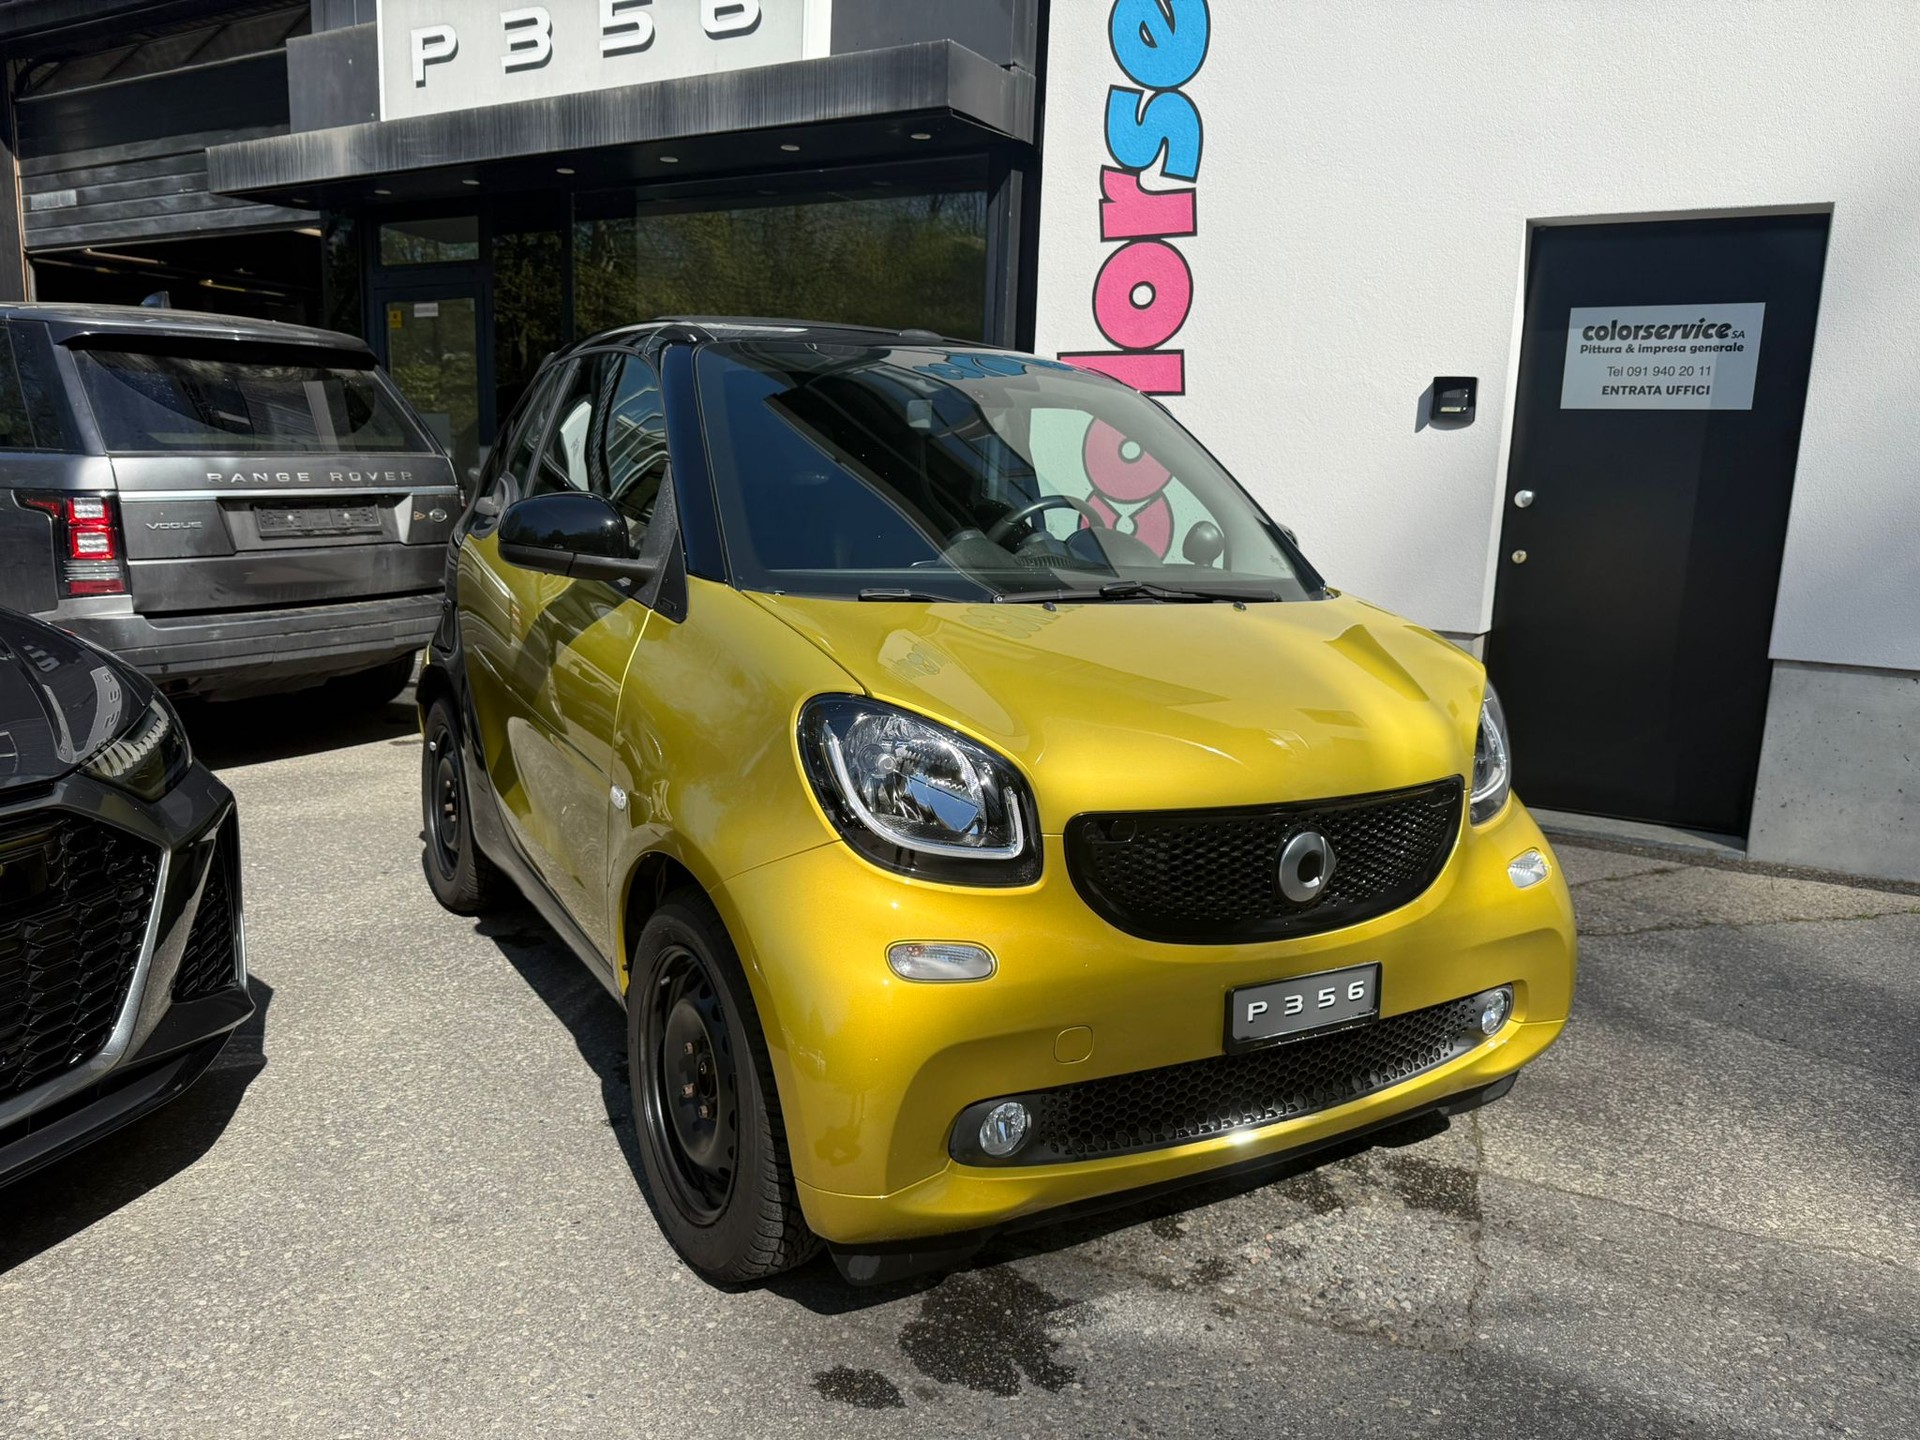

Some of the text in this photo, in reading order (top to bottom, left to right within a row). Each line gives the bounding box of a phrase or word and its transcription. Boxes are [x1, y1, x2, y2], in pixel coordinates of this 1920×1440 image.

[1582, 317, 1746, 342] colorservice SA
[1580, 342, 1745, 355] Pittura & impresa generale
[1606, 365, 1712, 377] Tel 091 940 20 11
[1601, 385, 1711, 396] ENTRATA UFFICI
[206, 471, 413, 484] RANGE ROVER
[146, 520, 203, 531] VOGUE
